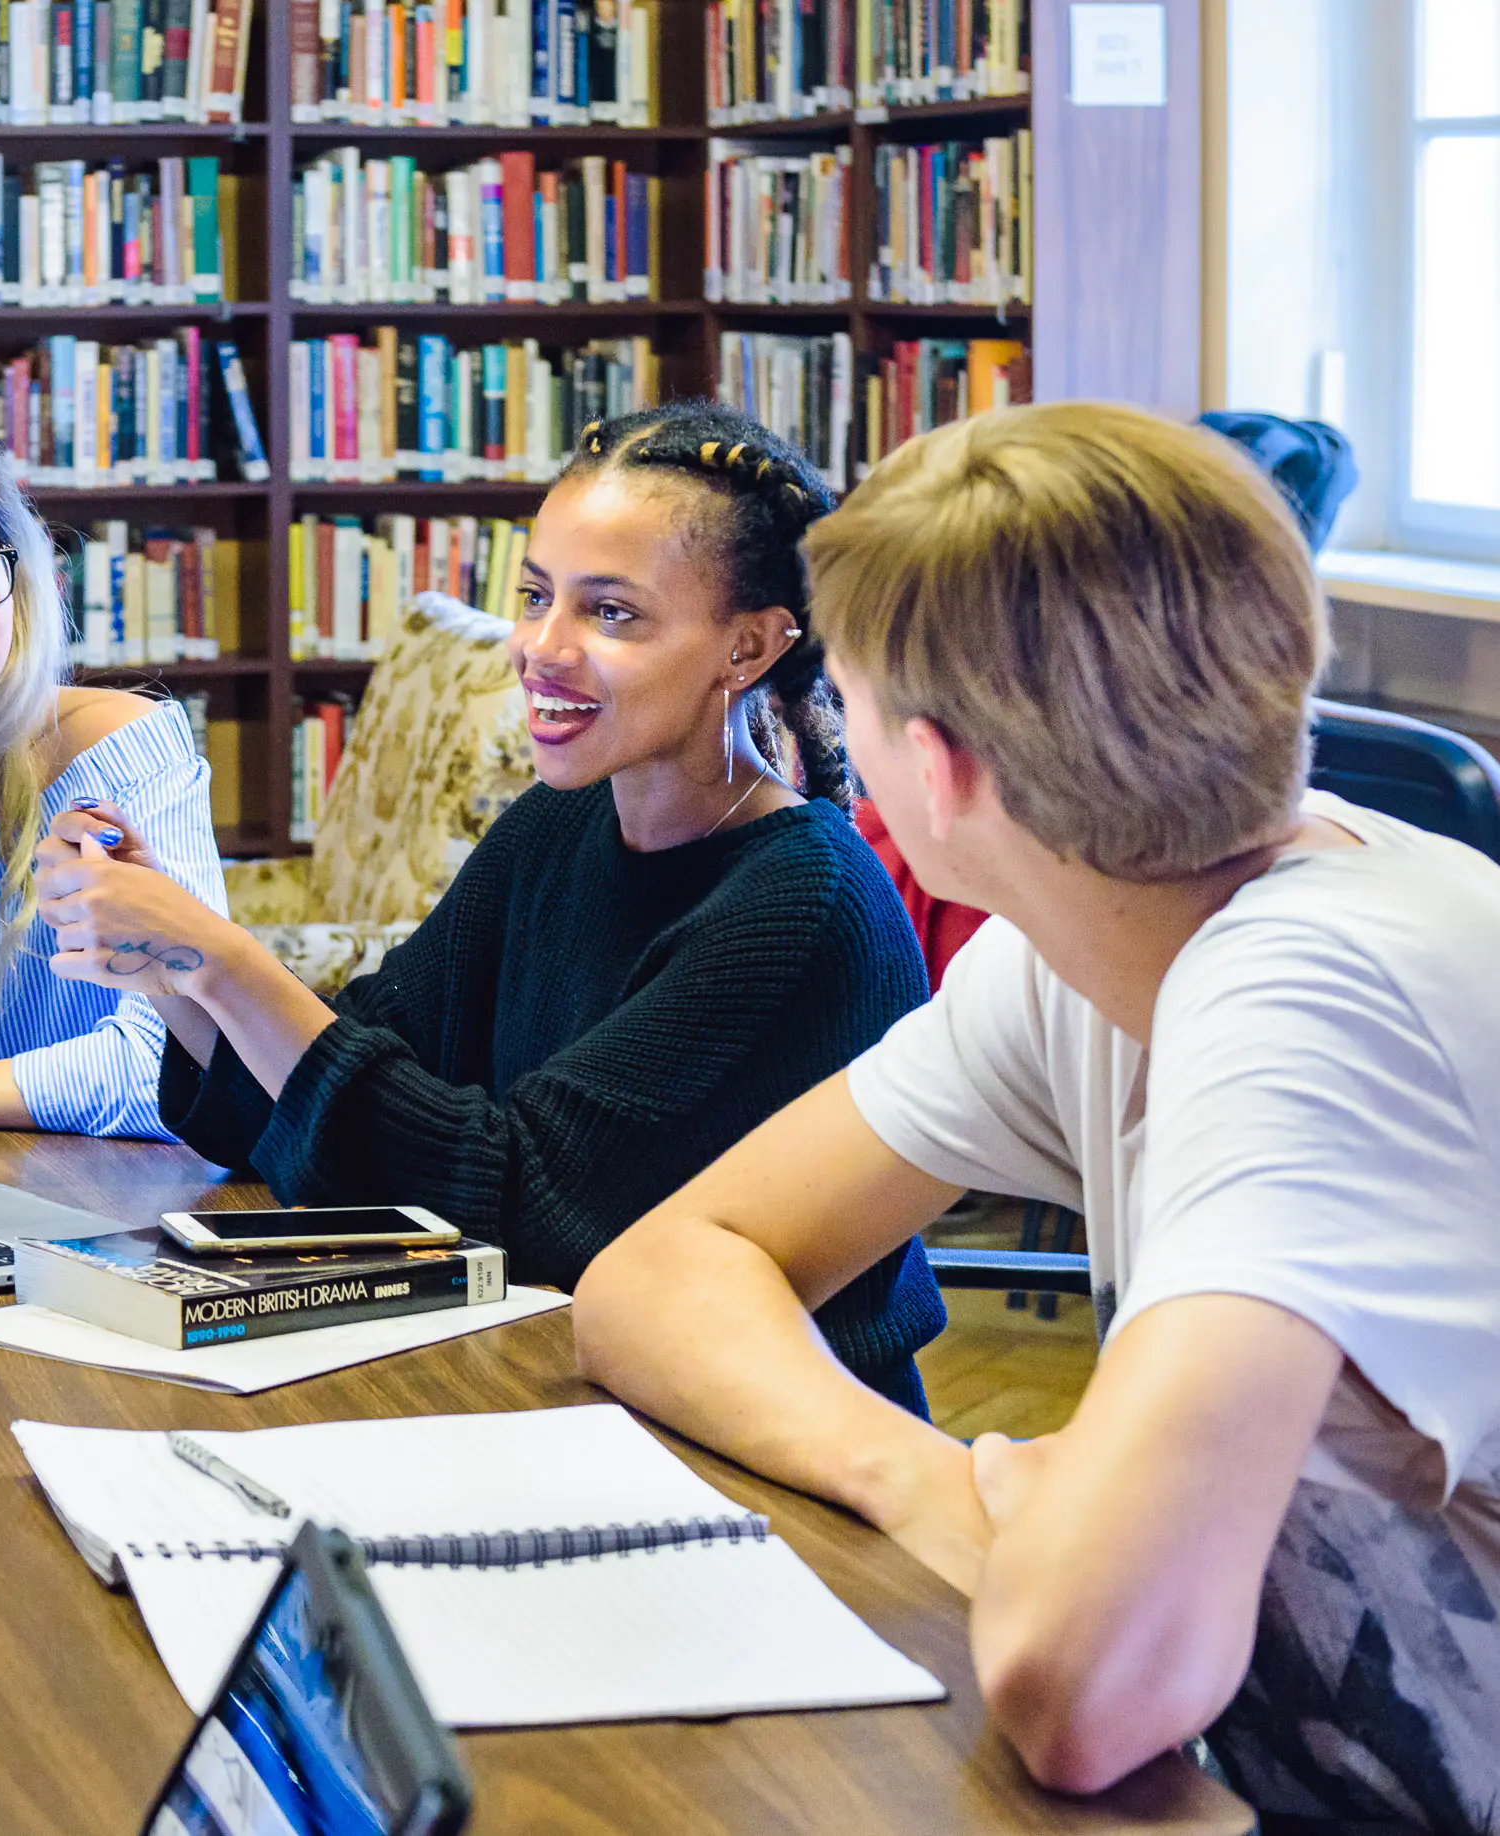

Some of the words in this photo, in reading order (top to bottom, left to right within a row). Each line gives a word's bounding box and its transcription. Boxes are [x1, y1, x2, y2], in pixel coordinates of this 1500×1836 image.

[184, 1299, 256, 1325] MODERN
[258, 1288, 308, 1314] BRITISH
[311, 1280, 369, 1308] DRAMA
[374, 1282, 411, 1299] INNES
